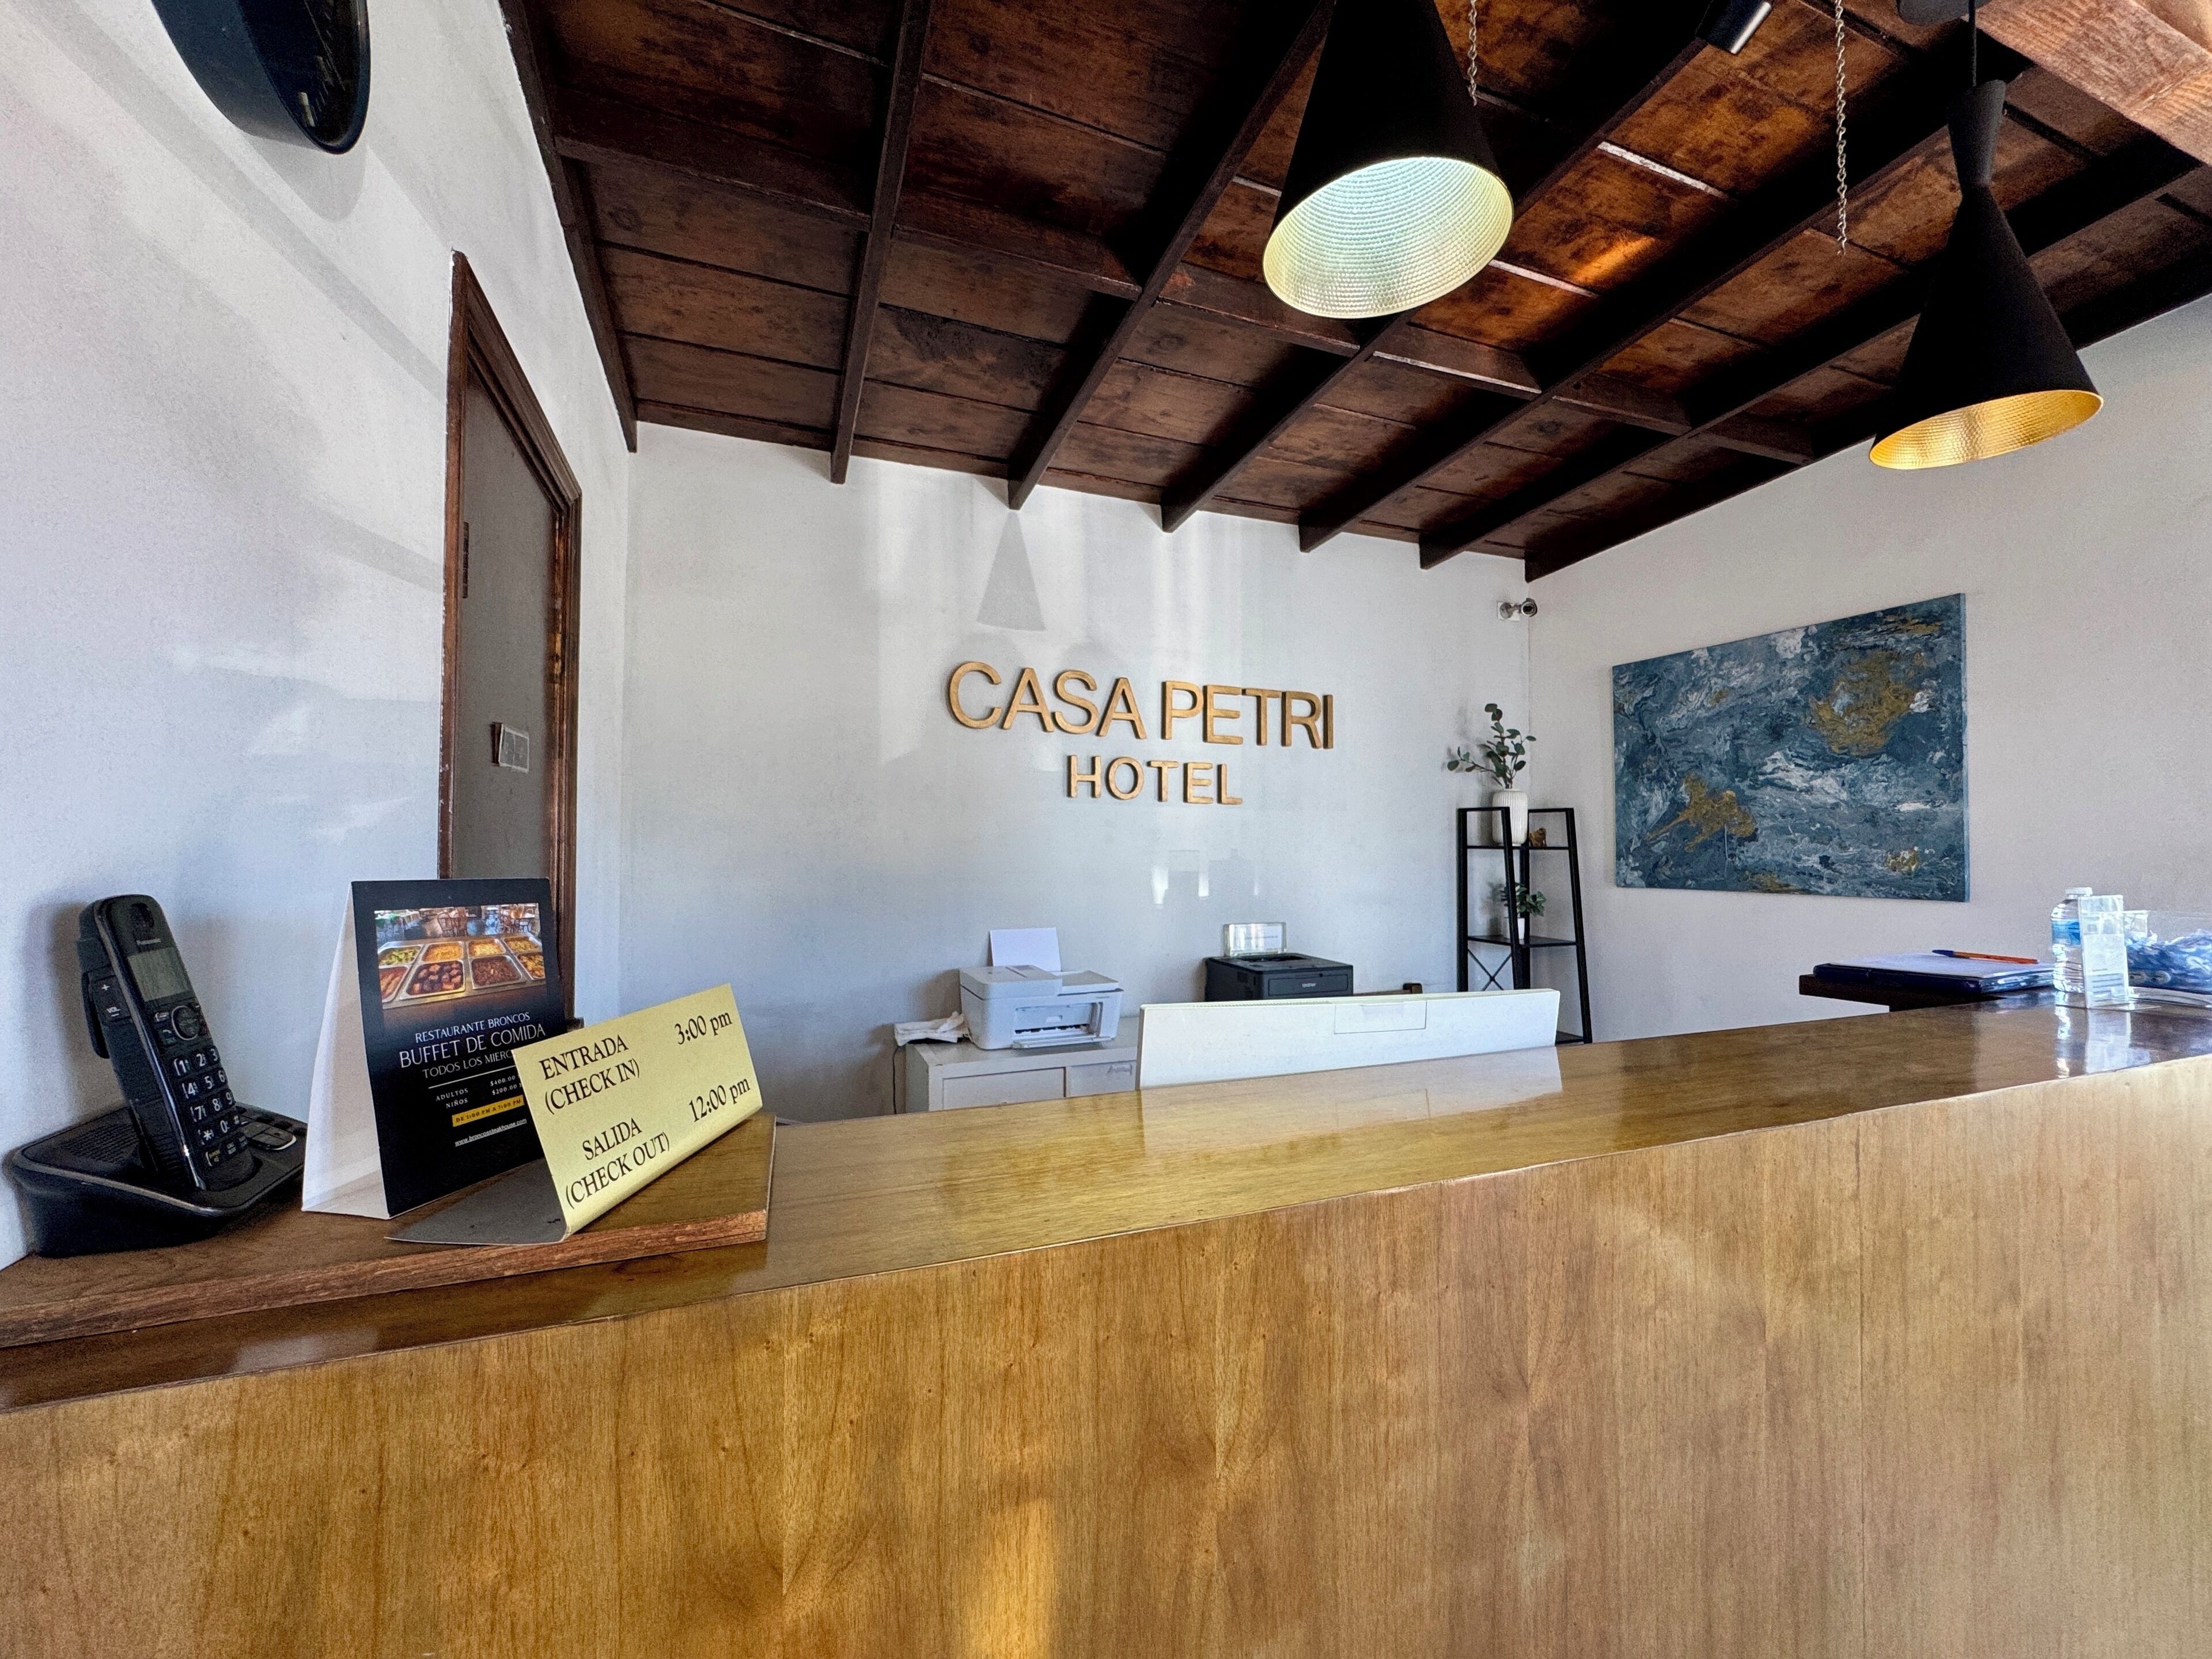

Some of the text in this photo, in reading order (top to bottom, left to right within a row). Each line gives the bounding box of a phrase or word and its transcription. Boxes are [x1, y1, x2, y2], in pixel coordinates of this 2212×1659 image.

[948, 661, 1334, 749] CASA PETRI
[1067, 755, 1243, 804] HOTEL
[399, 1024, 546, 1068] BUFFET DE COMIDA
[415, 1012, 531, 1043] RESTAURANTE BRONCOS
[675, 1012, 733, 1045] 3:00 pm
[179, 1048, 218, 1073] 1 2 3
[422, 1062, 460, 1078] TODOS
[463, 1056, 482, 1069] LOS
[539, 1034, 629, 1080] ENTRADA
[188, 1070, 225, 1096] 4 5 6
[436, 1088, 468, 1101] ADULTOS
[545, 1058, 640, 1115] (CHECK IN)
[688, 1078, 751, 1122] 12:00 pm
[194, 1105, 202, 1120] 7
[213, 1099, 221, 1111] 8
[446, 1097, 468, 1109] NIÑOS
[582, 1118, 642, 1160] SALIDA
[566, 1131, 670, 1209] (CHECK OUT)
